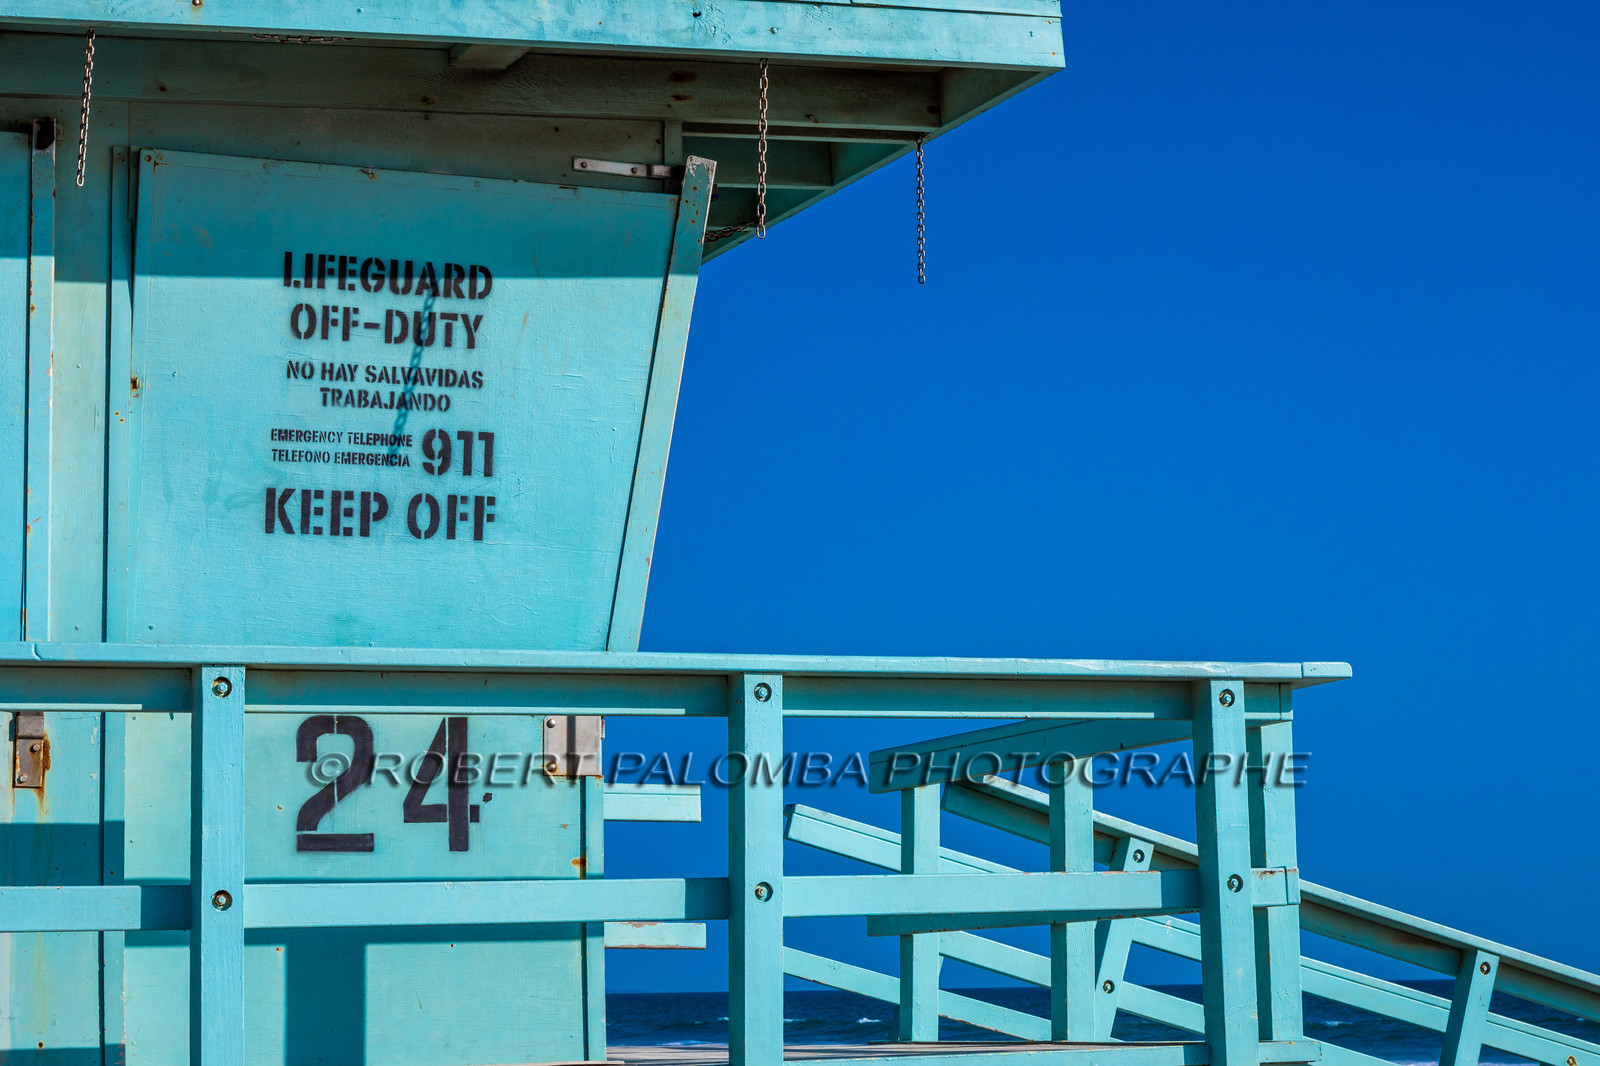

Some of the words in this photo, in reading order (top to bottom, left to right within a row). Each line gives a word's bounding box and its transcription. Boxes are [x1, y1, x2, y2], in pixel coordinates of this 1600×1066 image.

[284, 251, 493, 300] LIFEGUARD
[290, 303, 483, 349] OFF-DUTY
[286, 360, 315, 380] NO
[321, 362, 359, 382] HAY
[365, 365, 484, 389] SALVAVIDAS
[320, 387, 451, 412] TRABAJANDO
[270, 428, 343, 444] EMERGENCY
[347, 431, 413, 447] TELEPHONE
[271, 448, 331, 464] TELEFONO
[334, 452, 411, 467] EMERGENCIA
[422, 428, 495, 477] 911
[264, 487, 389, 537] KEEP
[407, 493, 496, 541] OFF
[296, 714, 480, 852] 24
